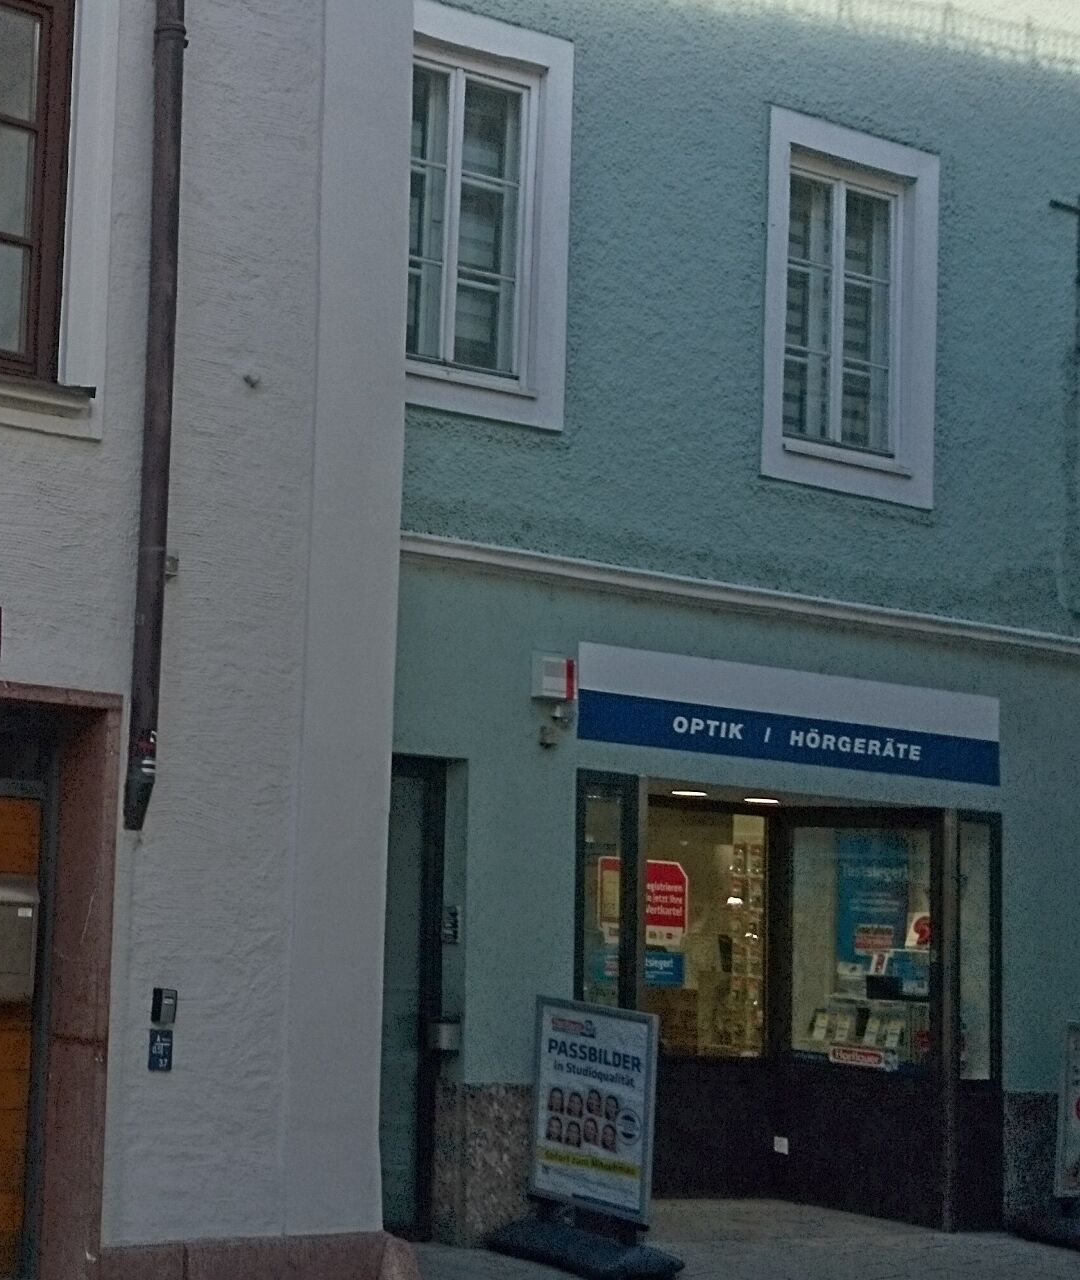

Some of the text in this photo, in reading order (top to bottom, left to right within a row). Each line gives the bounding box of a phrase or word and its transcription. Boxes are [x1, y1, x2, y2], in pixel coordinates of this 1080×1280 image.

[672, 715, 745, 740] OPTIK
[789, 728, 923, 761] HÖRGERÄTE
[646, 882, 683, 893] egistrieren
[548, 1037, 641, 1073] PASSBILDER
[566, 1061, 636, 1088] Studioqualität
